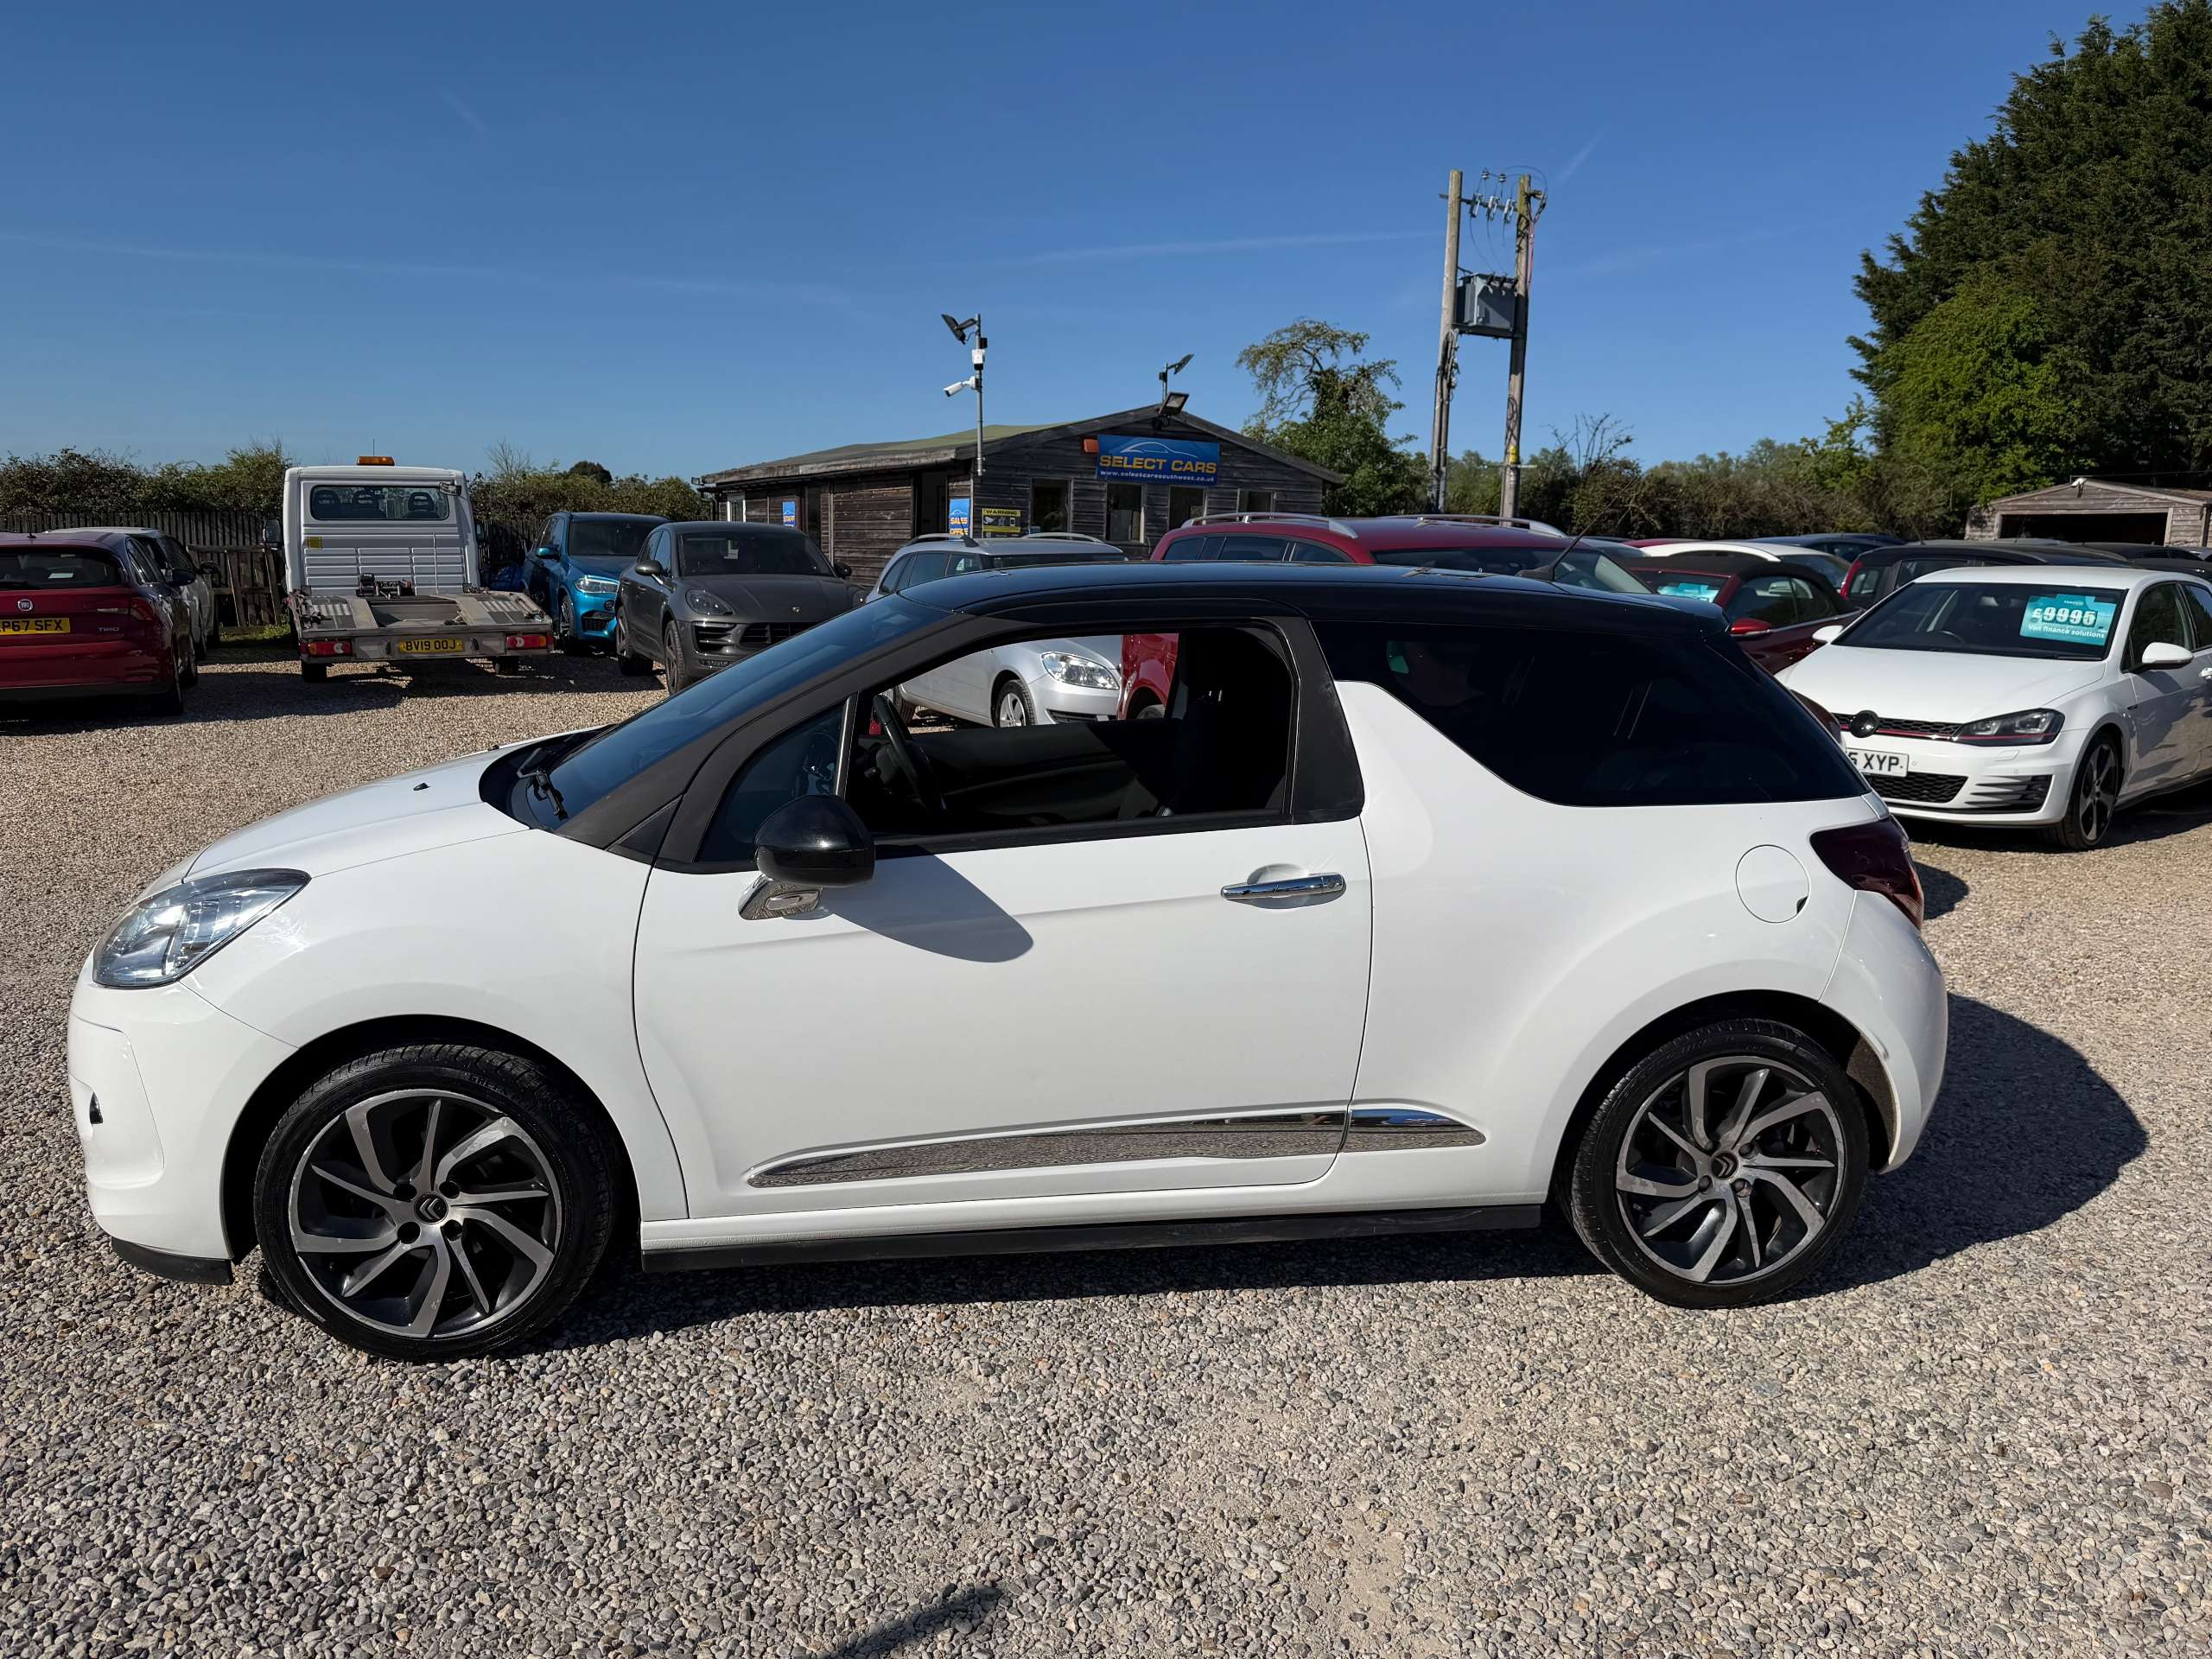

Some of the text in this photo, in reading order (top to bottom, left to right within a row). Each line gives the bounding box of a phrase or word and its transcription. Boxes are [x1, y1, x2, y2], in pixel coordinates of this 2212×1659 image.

[1099, 455, 1217, 474] SELECT CARS
[0, 620, 63, 632] P67 SFX
[2043, 626, 2069, 634] finance
[2071, 628, 2105, 639] solutions
[405, 640, 431, 652] BV19
[1863, 753, 1900, 772] XYP
